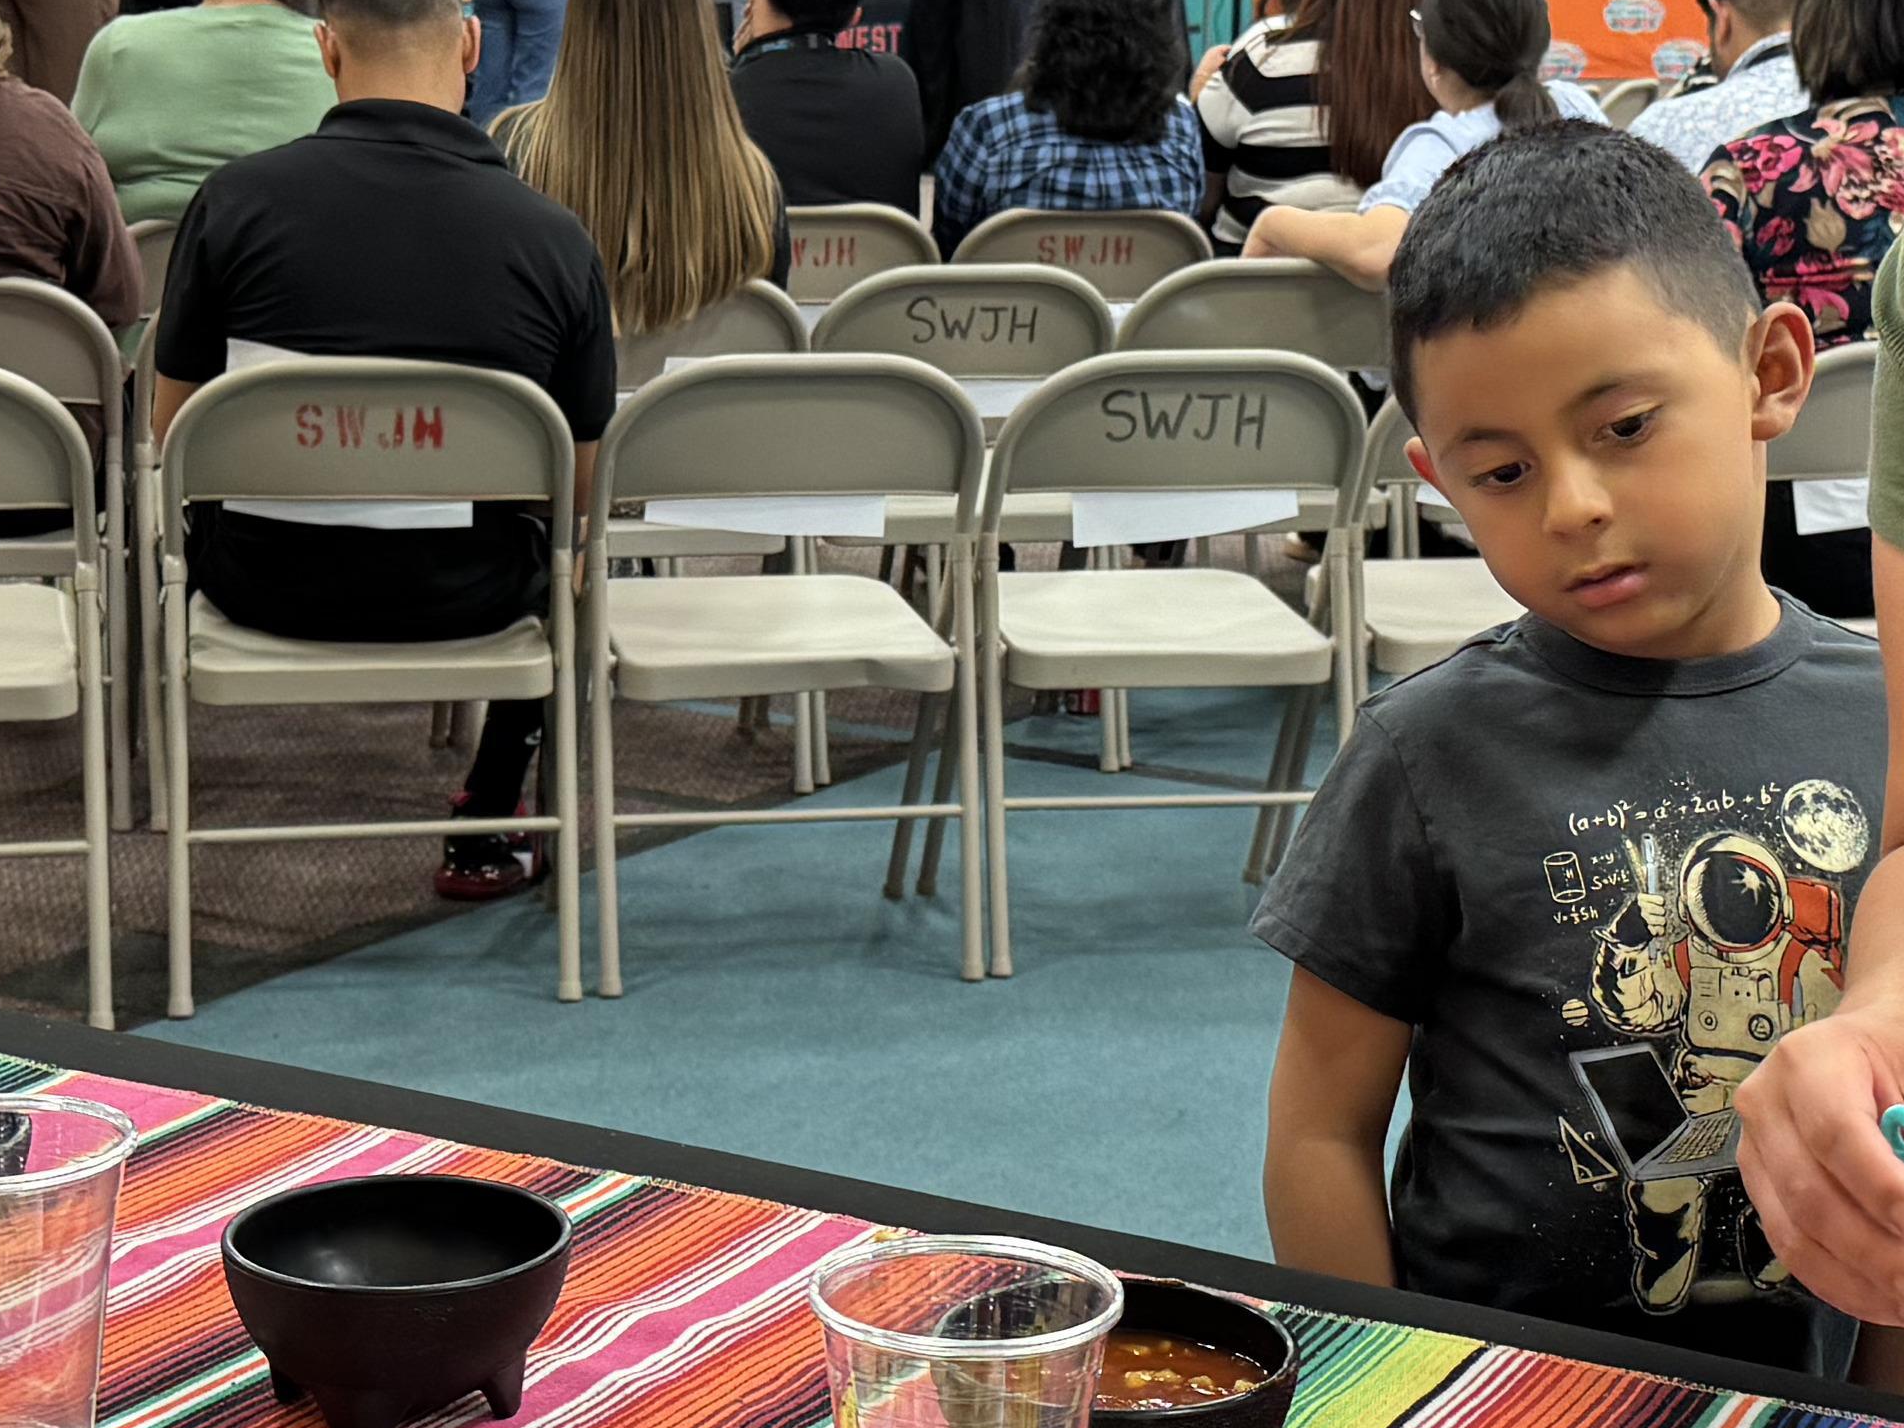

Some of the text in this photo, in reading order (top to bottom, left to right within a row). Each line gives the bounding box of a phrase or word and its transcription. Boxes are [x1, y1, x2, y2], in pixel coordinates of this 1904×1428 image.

[793, 236, 856, 267] WJH
[1038, 235, 1134, 264] SWJH
[906, 296, 1039, 345] SWJH
[296, 403, 444, 449] SWJH
[1101, 389, 1268, 450] SWJH
